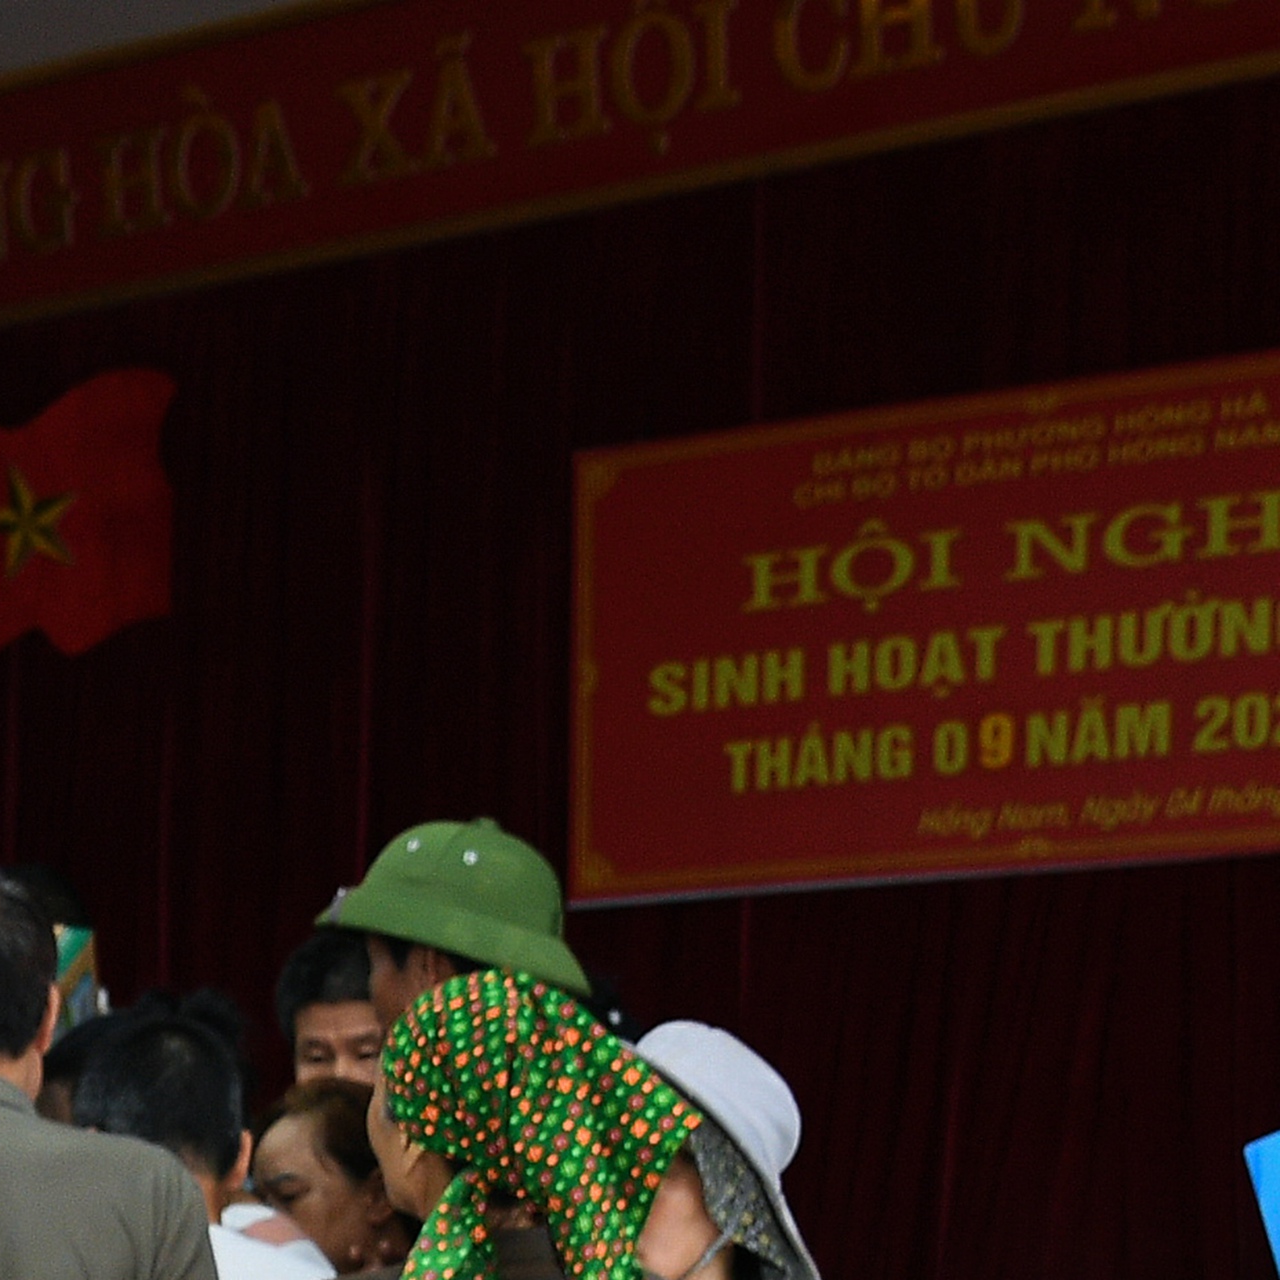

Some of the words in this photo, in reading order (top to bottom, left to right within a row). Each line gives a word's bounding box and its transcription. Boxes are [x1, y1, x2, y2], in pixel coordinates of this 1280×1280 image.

[96, 82, 311, 242] HÒA
[331, 28, 497, 187] XÃ
[741, 515, 964, 615] HỘI
[646, 644, 806, 718] SINH
[827, 622, 1009, 700] HOẠT
[1025, 586, 1280, 679] THƯỜN
[723, 718, 916, 796] THÁNG
[1024, 692, 1175, 771] NĂM
